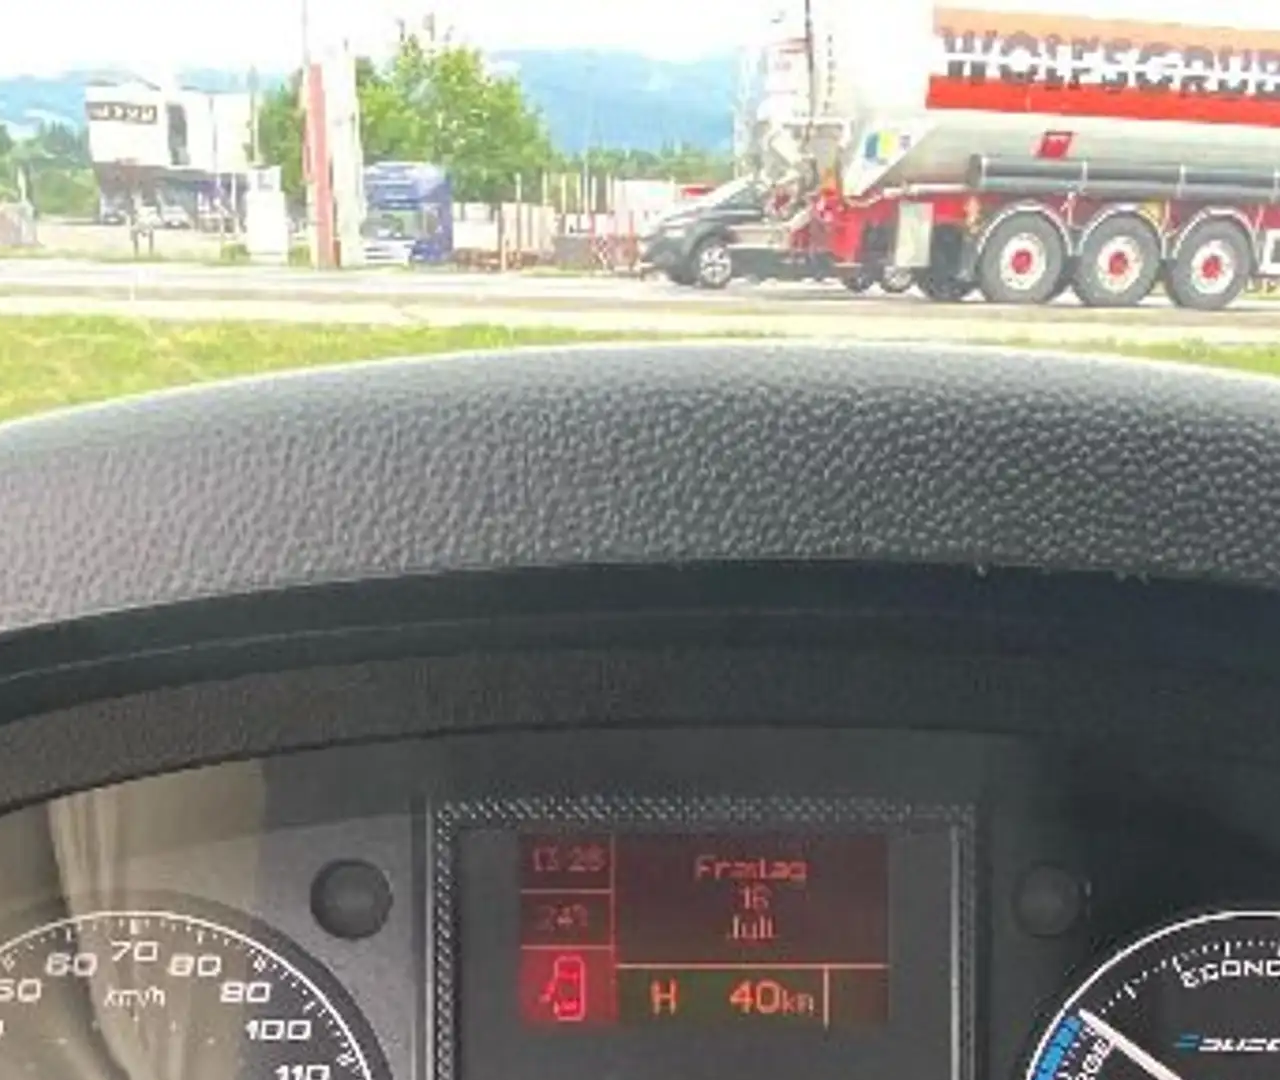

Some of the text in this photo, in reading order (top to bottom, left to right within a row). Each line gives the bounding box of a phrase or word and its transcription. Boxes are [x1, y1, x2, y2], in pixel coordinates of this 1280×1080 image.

[110, 941, 159, 963] 70
[44, 952, 99, 977] 60
[166, 955, 222, 978] 80
[103, 984, 166, 1009] km/h
[220, 981, 272, 1004] 90
[650, 978, 680, 1016] H
[245, 1019, 312, 1042] 100
